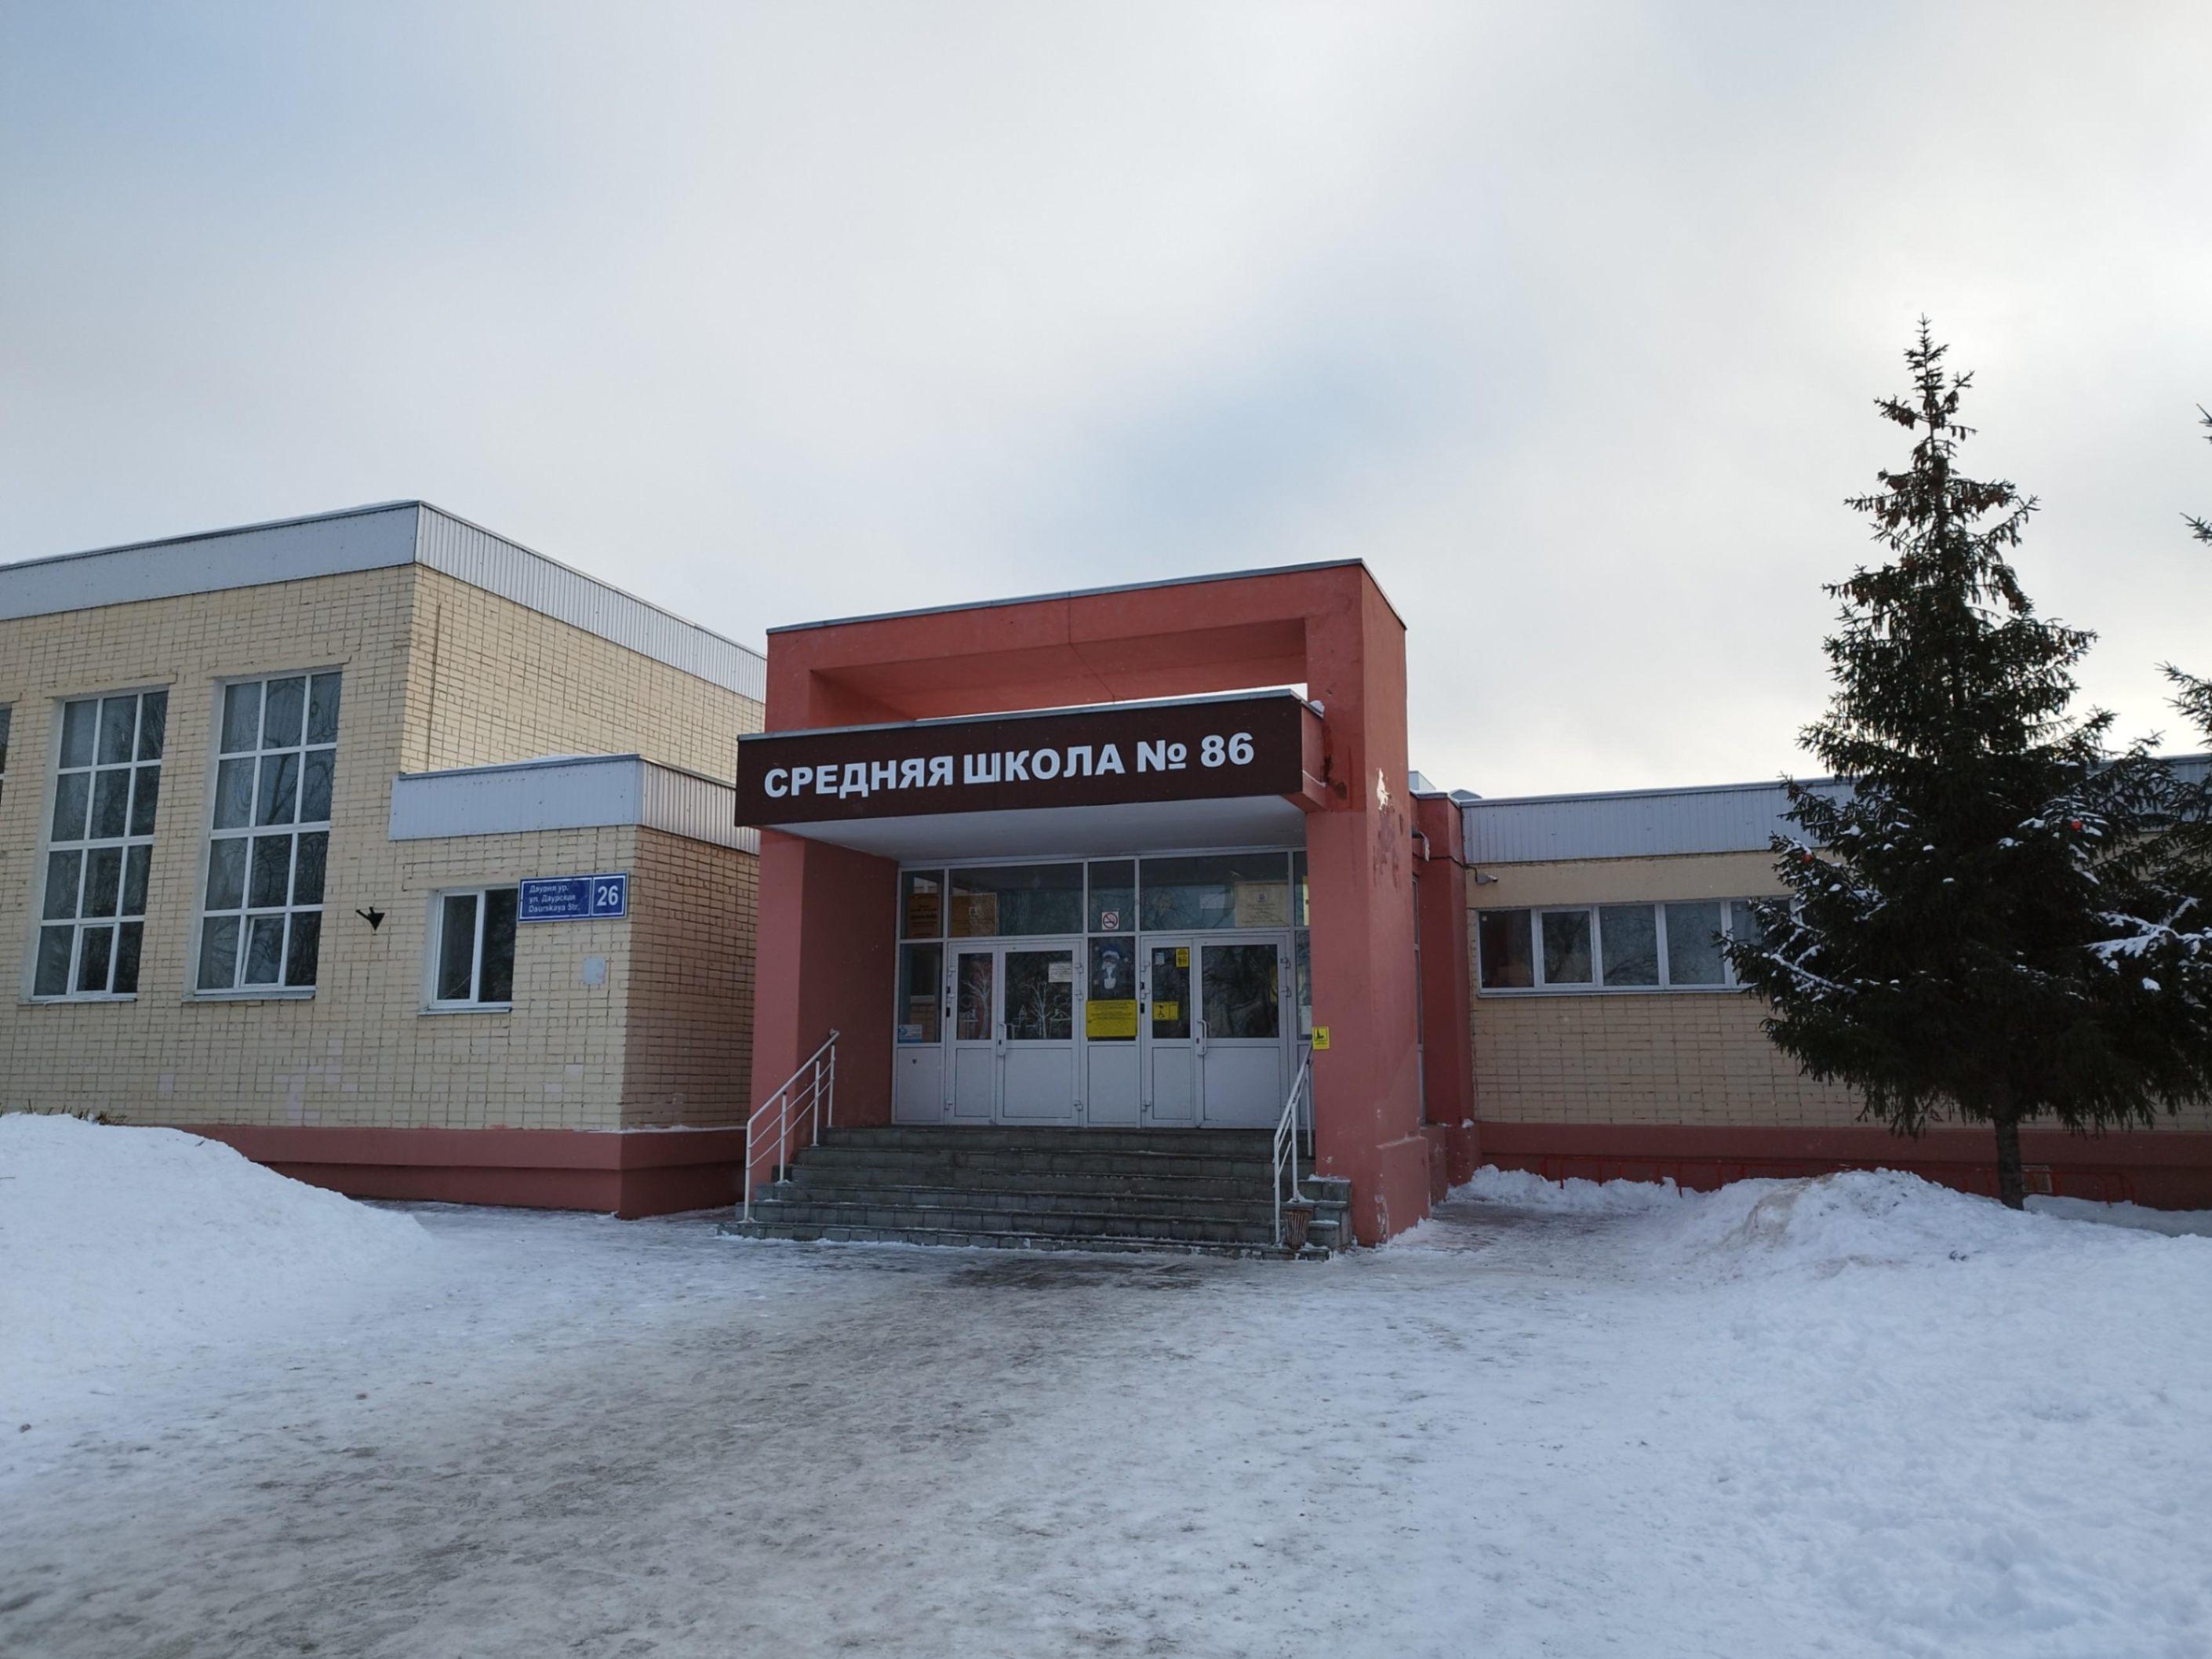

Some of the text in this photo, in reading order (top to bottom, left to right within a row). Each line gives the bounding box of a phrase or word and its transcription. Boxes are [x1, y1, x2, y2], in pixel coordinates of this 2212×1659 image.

[763, 732, 1254, 799] СРЕДНЯЯ ШКОЛА № 86
[541, 894, 576, 903] Даурская
[597, 885, 619, 906] 26
[529, 904, 566, 913] Daurskaya
